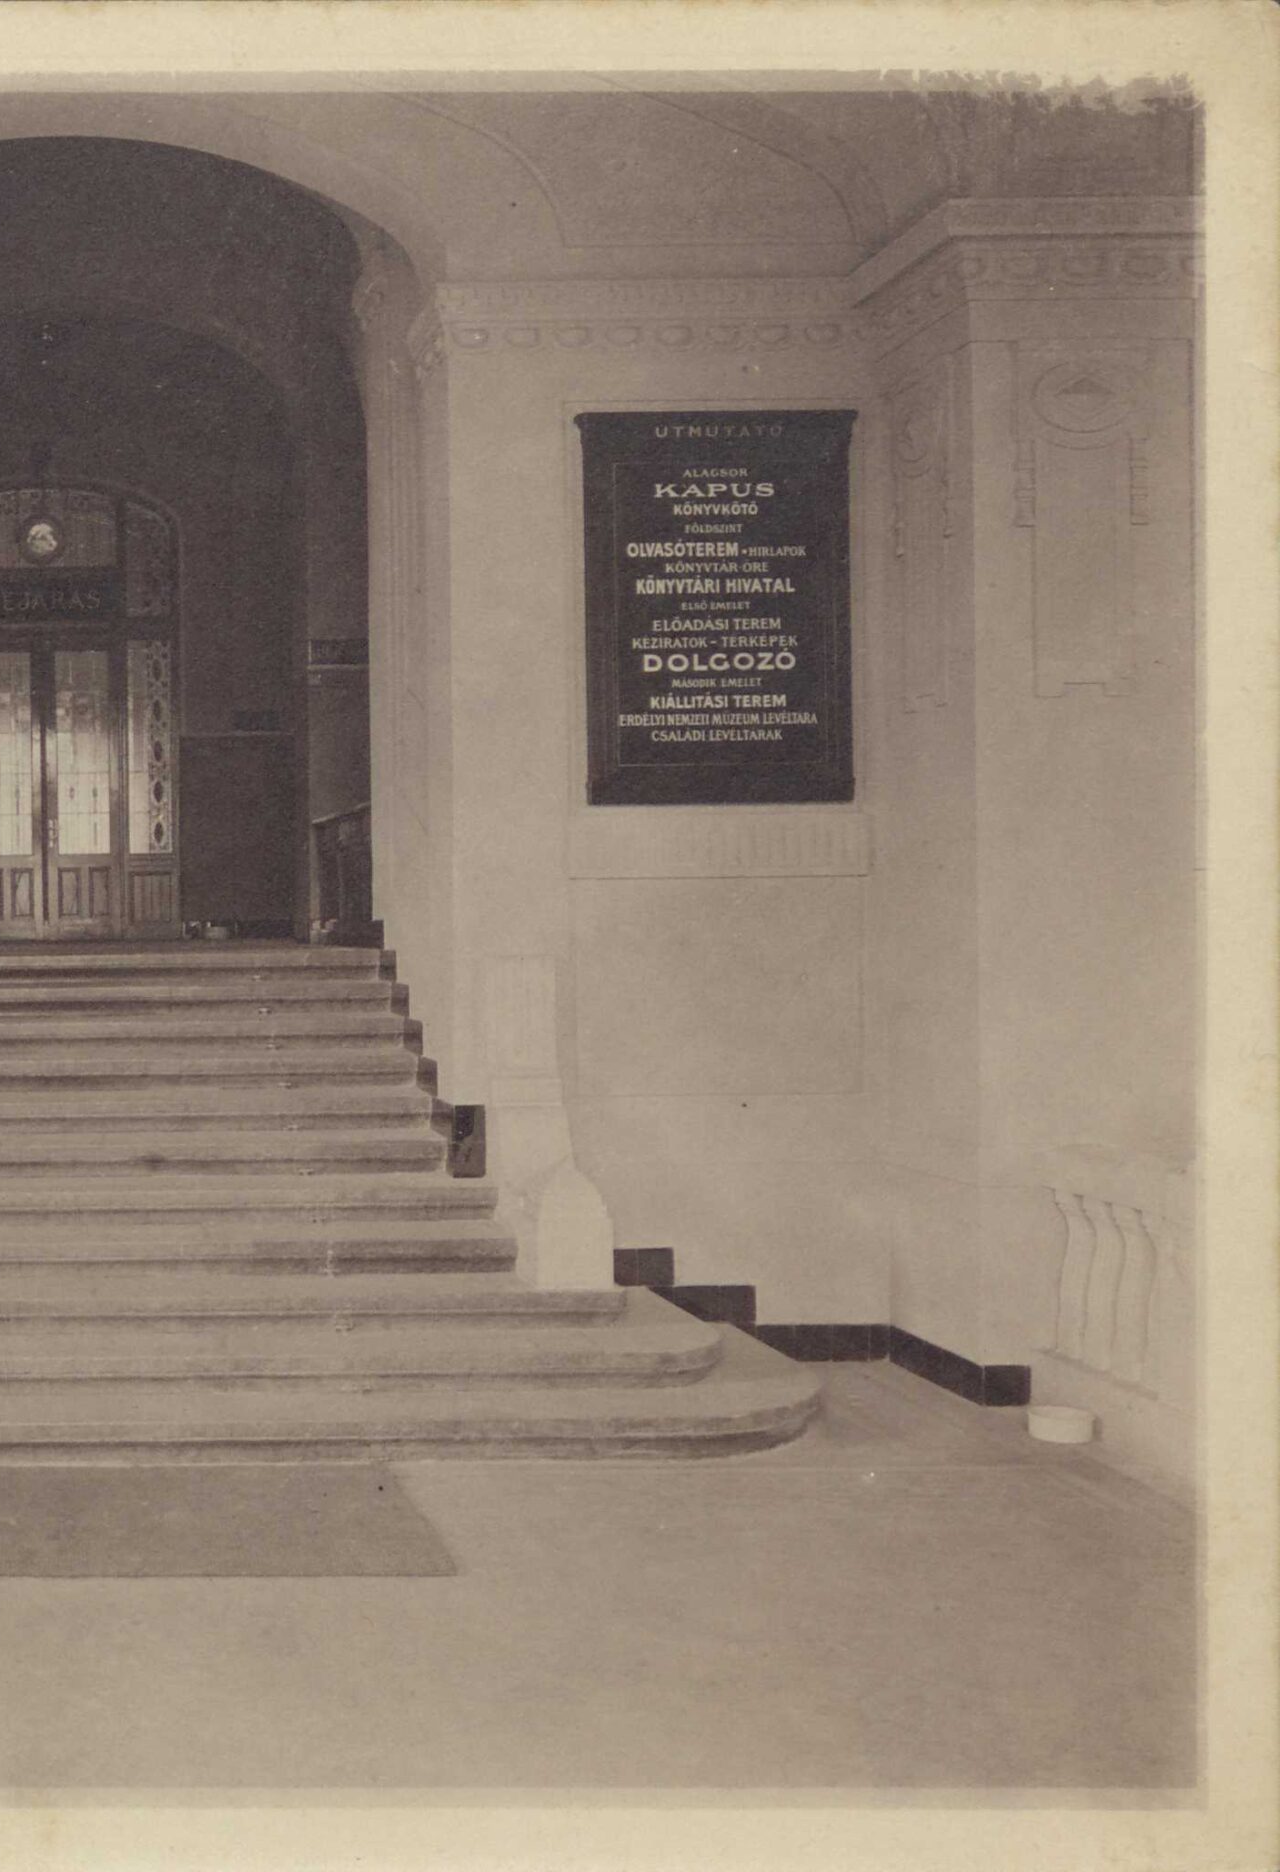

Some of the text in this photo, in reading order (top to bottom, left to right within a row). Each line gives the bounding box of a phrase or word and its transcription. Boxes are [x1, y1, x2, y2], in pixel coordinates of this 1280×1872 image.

[683, 468, 748, 478] ALAGSOR
[654, 483, 774, 498] KAPUS
[627, 539, 739, 557] OLVASÓTEREM
[726, 578, 795, 593] HIVATAL
[710, 601, 750, 610] EMELET
[734, 618, 781, 630] TEREM
[643, 649, 796, 672] DOLGOZÓ
[721, 678, 762, 687] EMELET
[734, 695, 787, 707] TEREM
